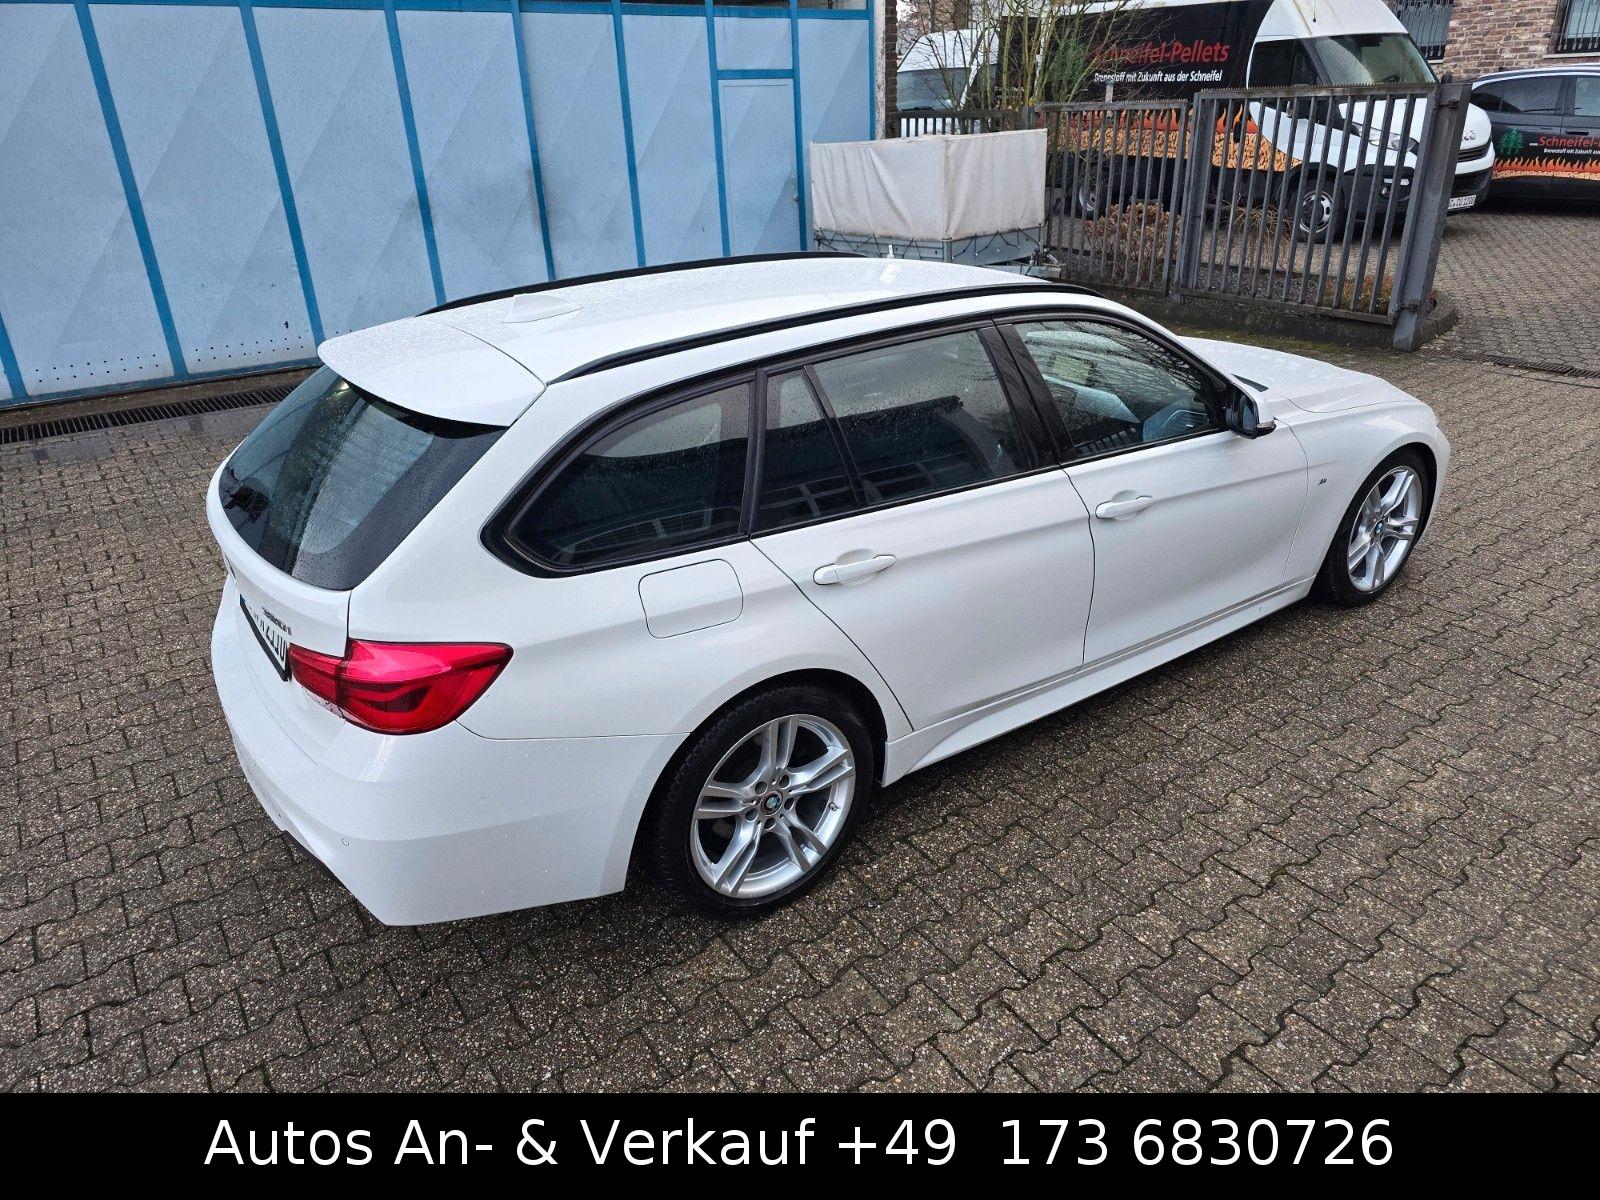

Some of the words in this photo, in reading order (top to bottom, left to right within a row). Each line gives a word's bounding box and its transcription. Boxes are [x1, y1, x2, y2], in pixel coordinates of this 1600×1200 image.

[1137, 71, 1164, 82] Zukunft
[1164, 73, 1176, 82] aus
[1176, 71, 1189, 82] der
[1190, 69, 1223, 82] Schneifel
